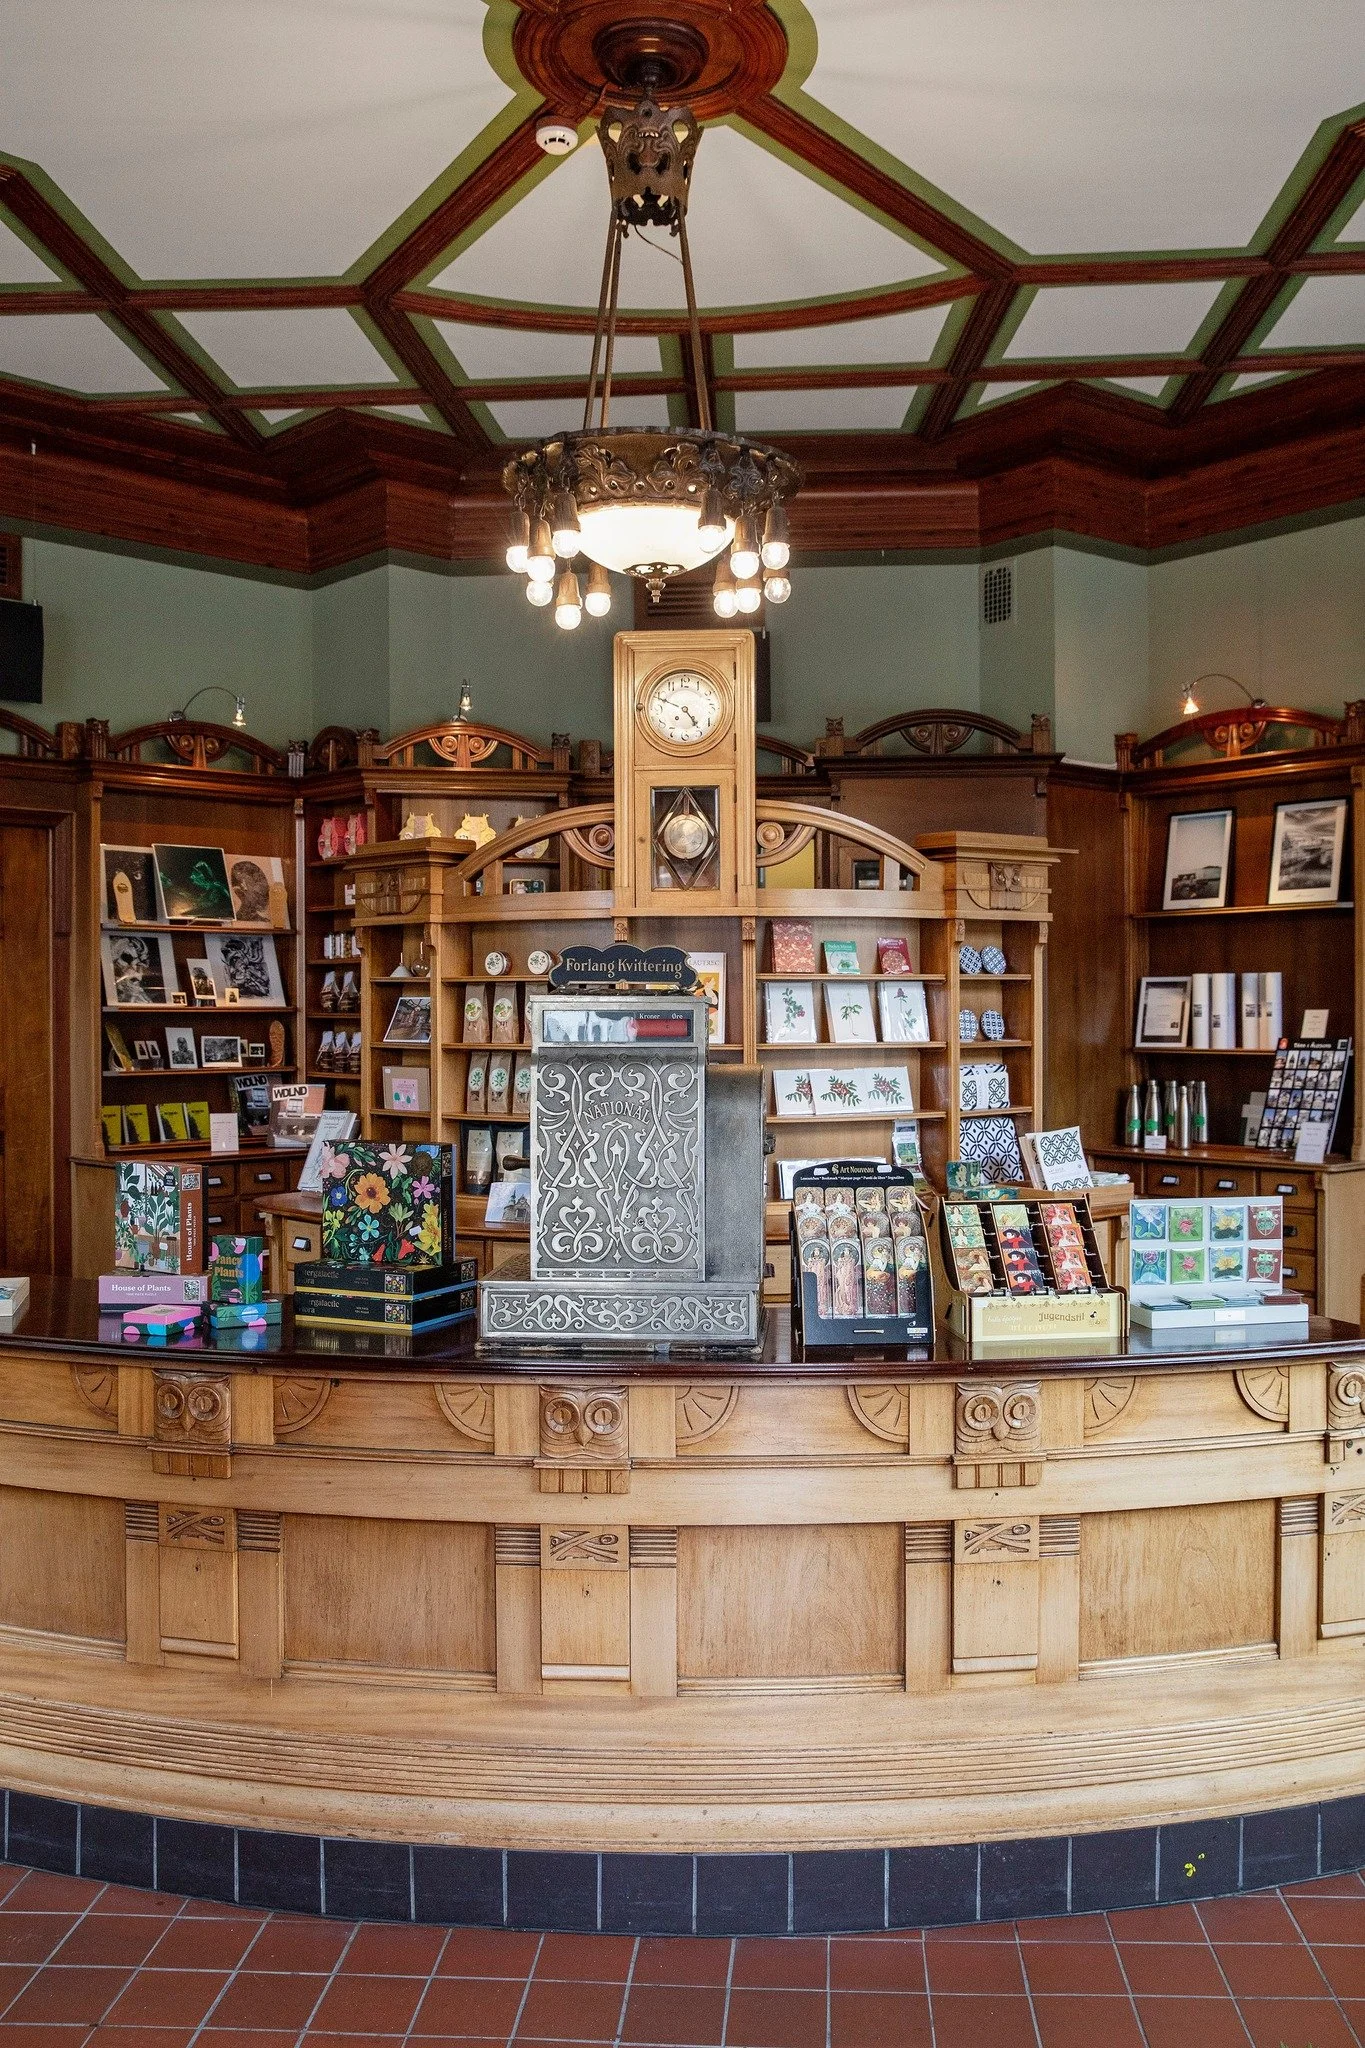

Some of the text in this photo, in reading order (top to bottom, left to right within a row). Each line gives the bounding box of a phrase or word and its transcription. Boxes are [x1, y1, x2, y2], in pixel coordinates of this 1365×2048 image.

[667, 681, 675, 691] 11
[680, 677, 691, 688] 12
[566, 958, 683, 979] Forlang Kvittering
[582, 1100, 651, 1125] NATIONAL
[840, 1166, 875, 1174] Art Nouveau
[186, 1226, 192, 1235] of
[214, 1266, 244, 1279] Plants
[111, 1284, 172, 1292] House of Plants
[1038, 1312, 1086, 1323] Jugendstil
